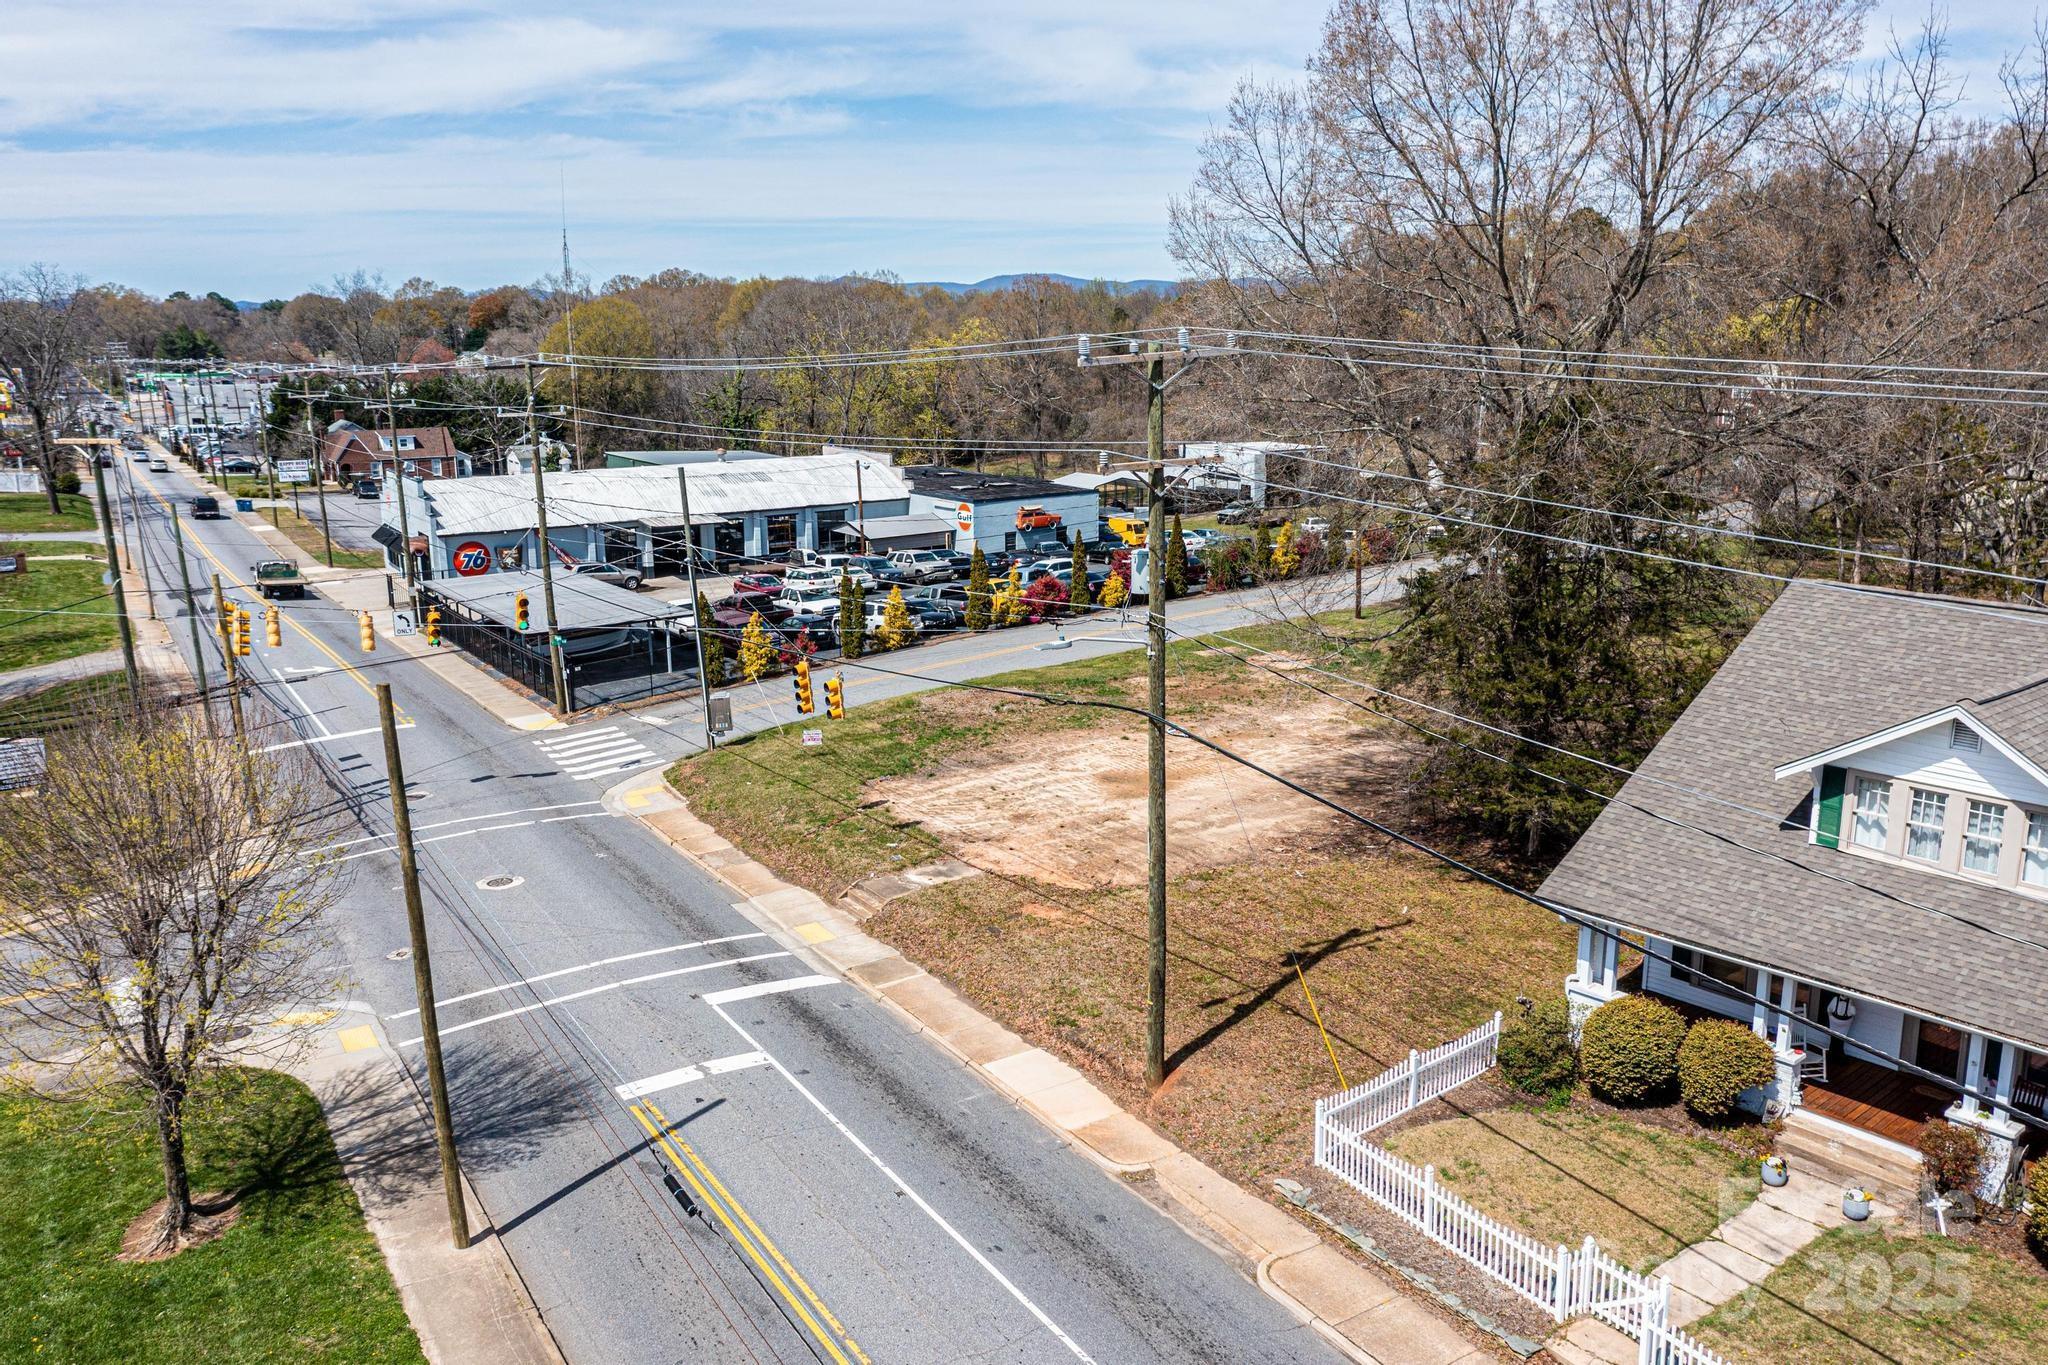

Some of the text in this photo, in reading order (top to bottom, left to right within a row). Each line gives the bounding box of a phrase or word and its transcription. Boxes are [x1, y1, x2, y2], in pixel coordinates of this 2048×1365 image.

[957, 512, 972, 522] Gulf
[460, 549, 487, 571] 76
[396, 627, 413, 635] ONLY
